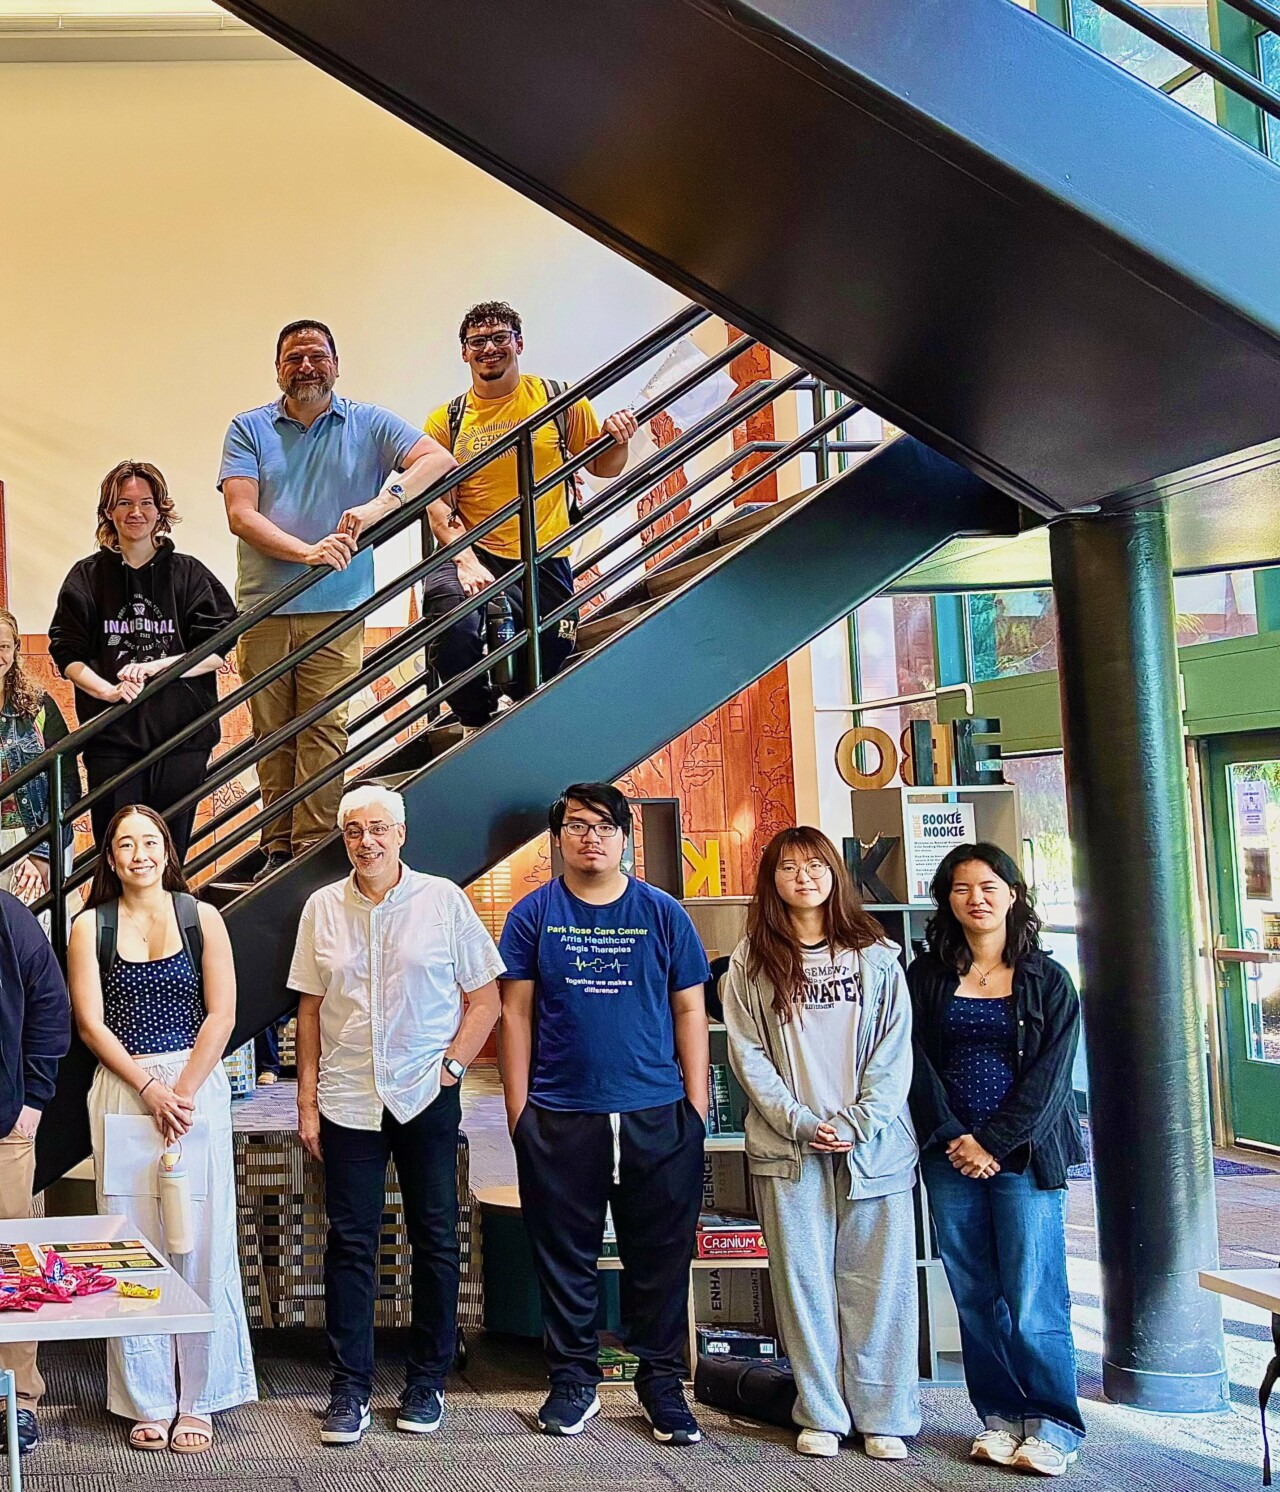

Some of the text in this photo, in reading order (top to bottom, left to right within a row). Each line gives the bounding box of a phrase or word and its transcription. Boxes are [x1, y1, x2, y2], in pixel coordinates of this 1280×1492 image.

[473, 433, 507, 442] ACTIV
[103, 617, 176, 634] INAUGURAL
[558, 619, 576, 634] PL
[922, 813, 962, 825] BOOKIE
[923, 825, 965, 838] NOOKIE
[569, 926, 592, 934] Rose
[593, 927, 616, 935] Care
[617, 927, 649, 935] Center
[584, 936, 636, 944] Healthcare
[565, 944, 632, 954] Aegis Therapies
[565, 977, 595, 986] Together
[584, 986, 619, 994] difference
[703, 1154, 716, 1208] CIENCE
[709, 1268, 722, 1310] ENHA
[751, 1279, 761, 1324] CAMPAIGN
[707, 1346, 731, 1354] WARS
